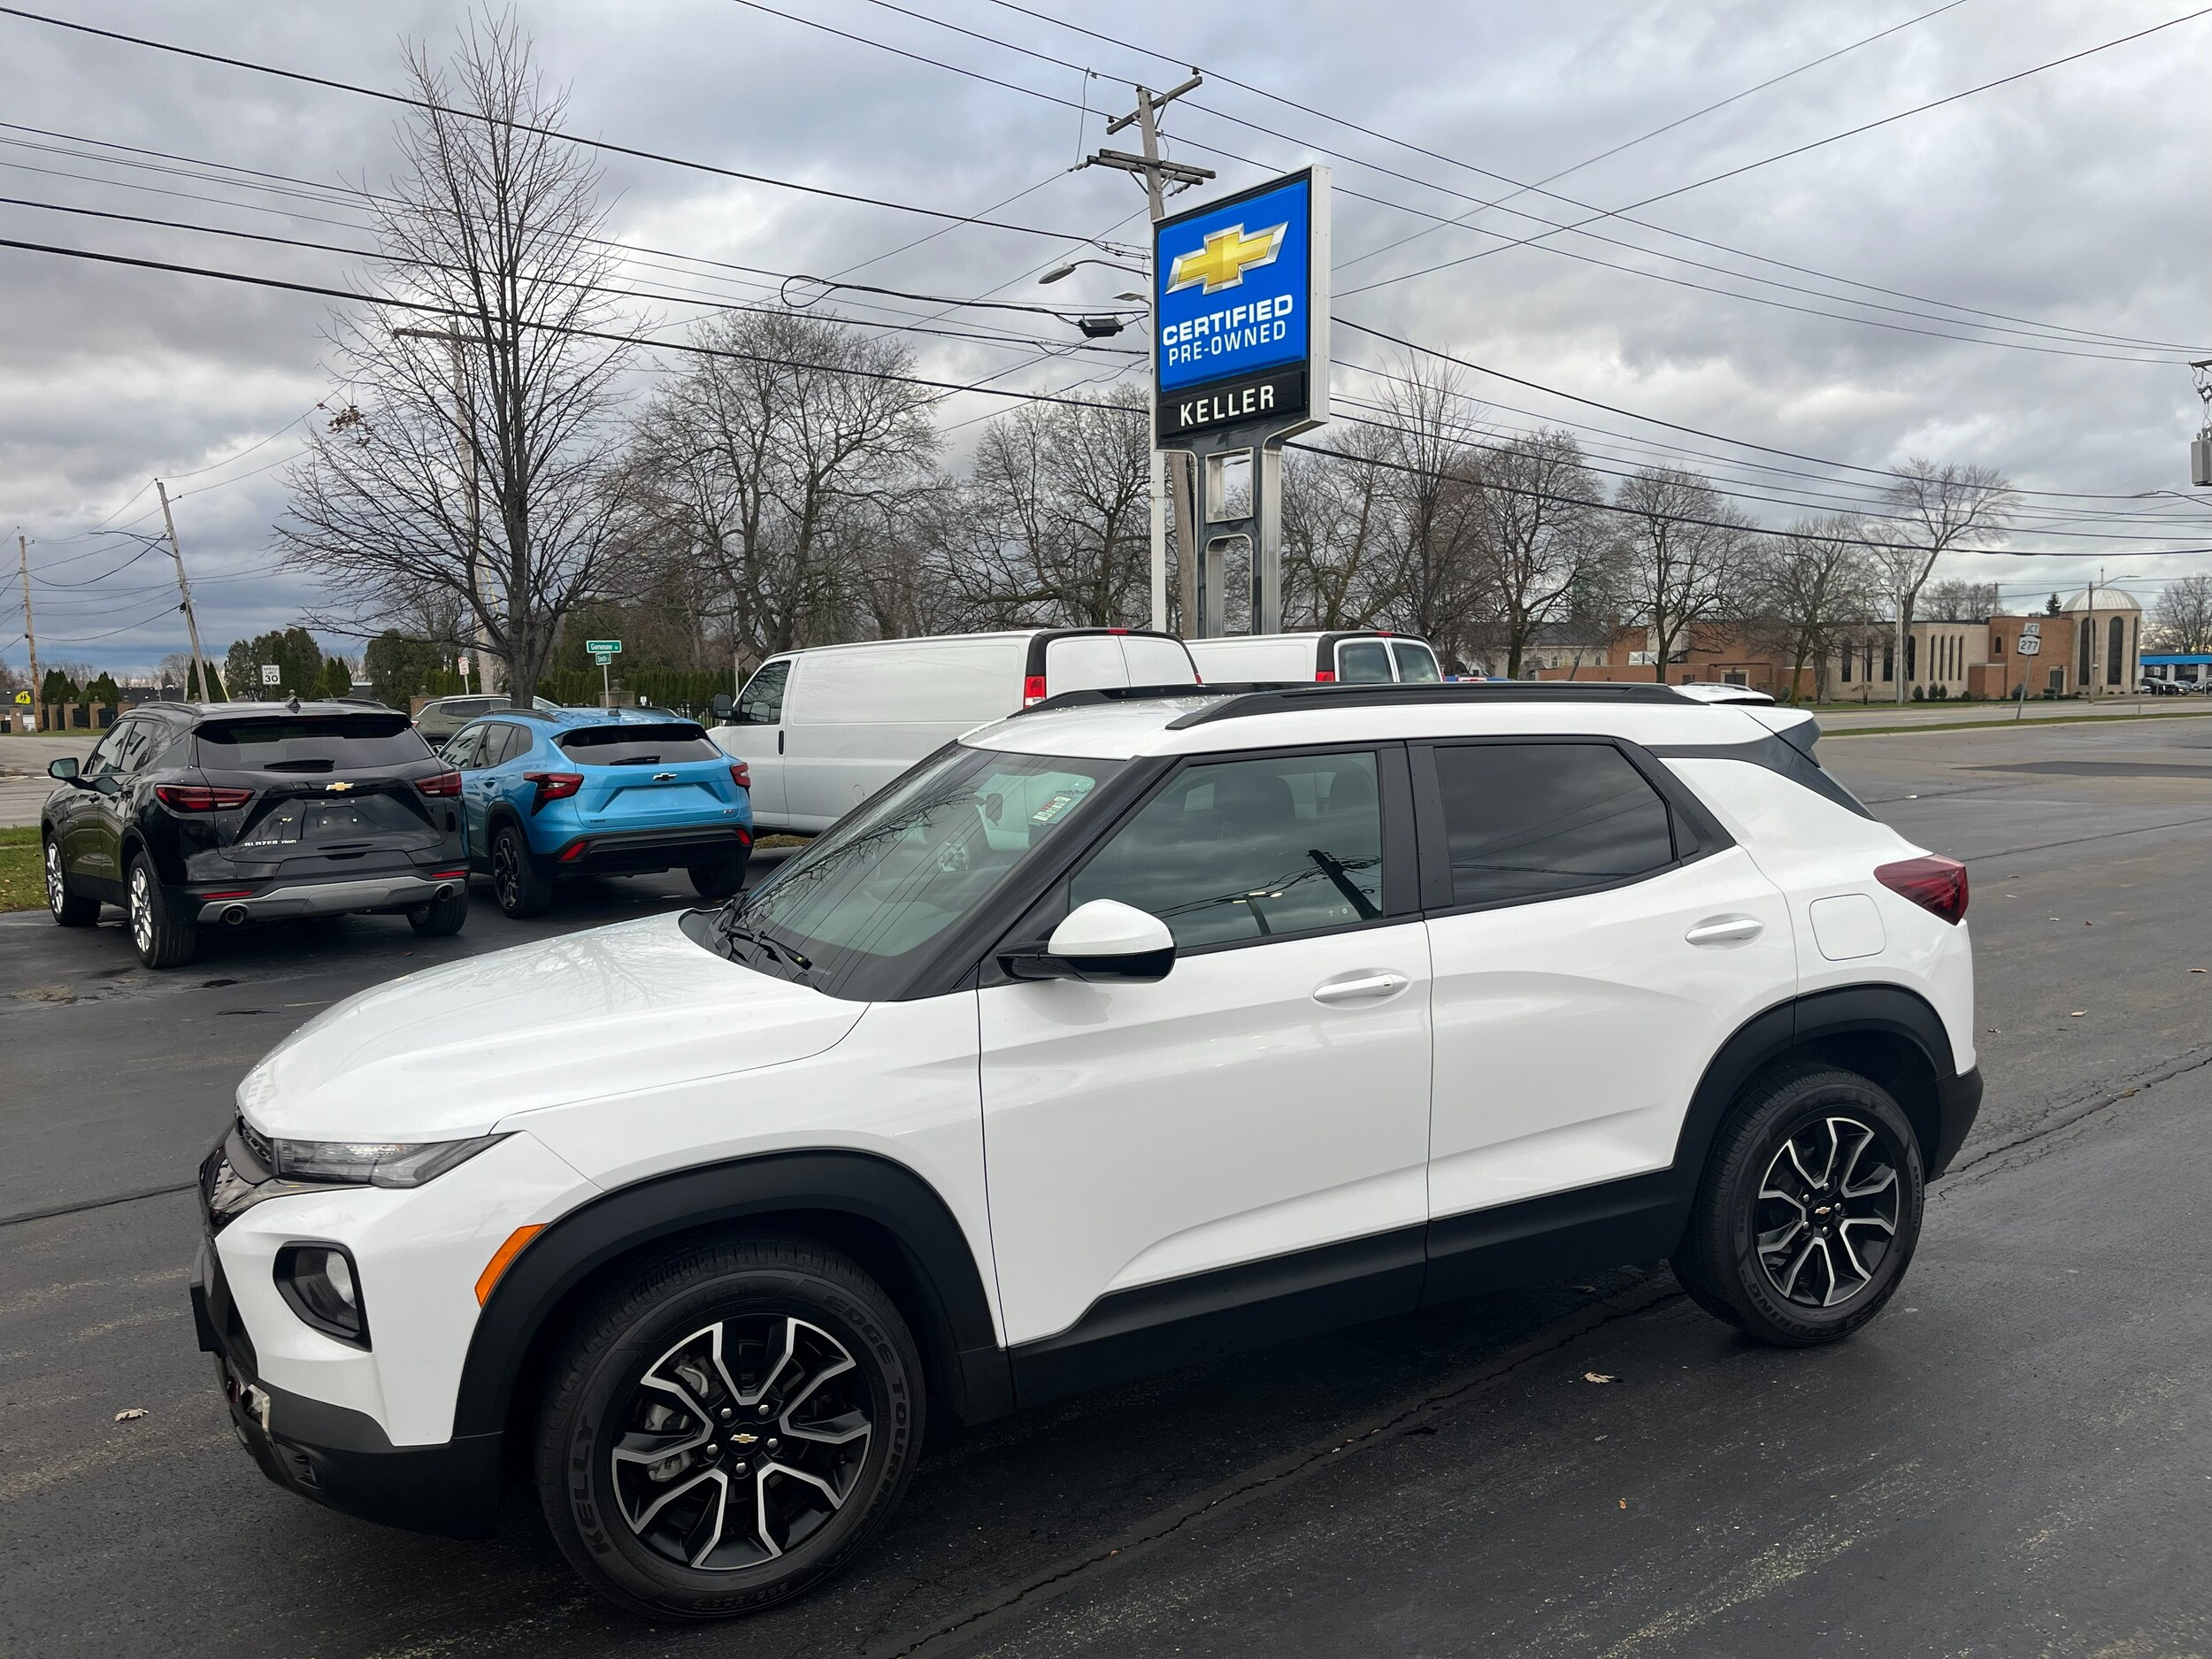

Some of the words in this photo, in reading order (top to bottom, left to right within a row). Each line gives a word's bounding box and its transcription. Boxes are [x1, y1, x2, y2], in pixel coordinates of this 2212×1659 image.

[1163, 294, 1293, 347] CERTIFIED
[1169, 319, 1286, 366] PRE-OWNED
[1180, 384, 1274, 426] KELLER
[2020, 641, 2039, 650] 277
[2025, 625, 2039, 634] JCT
[824, 1294, 895, 1363] EDGE
[573, 1415, 612, 1555] KELLY
